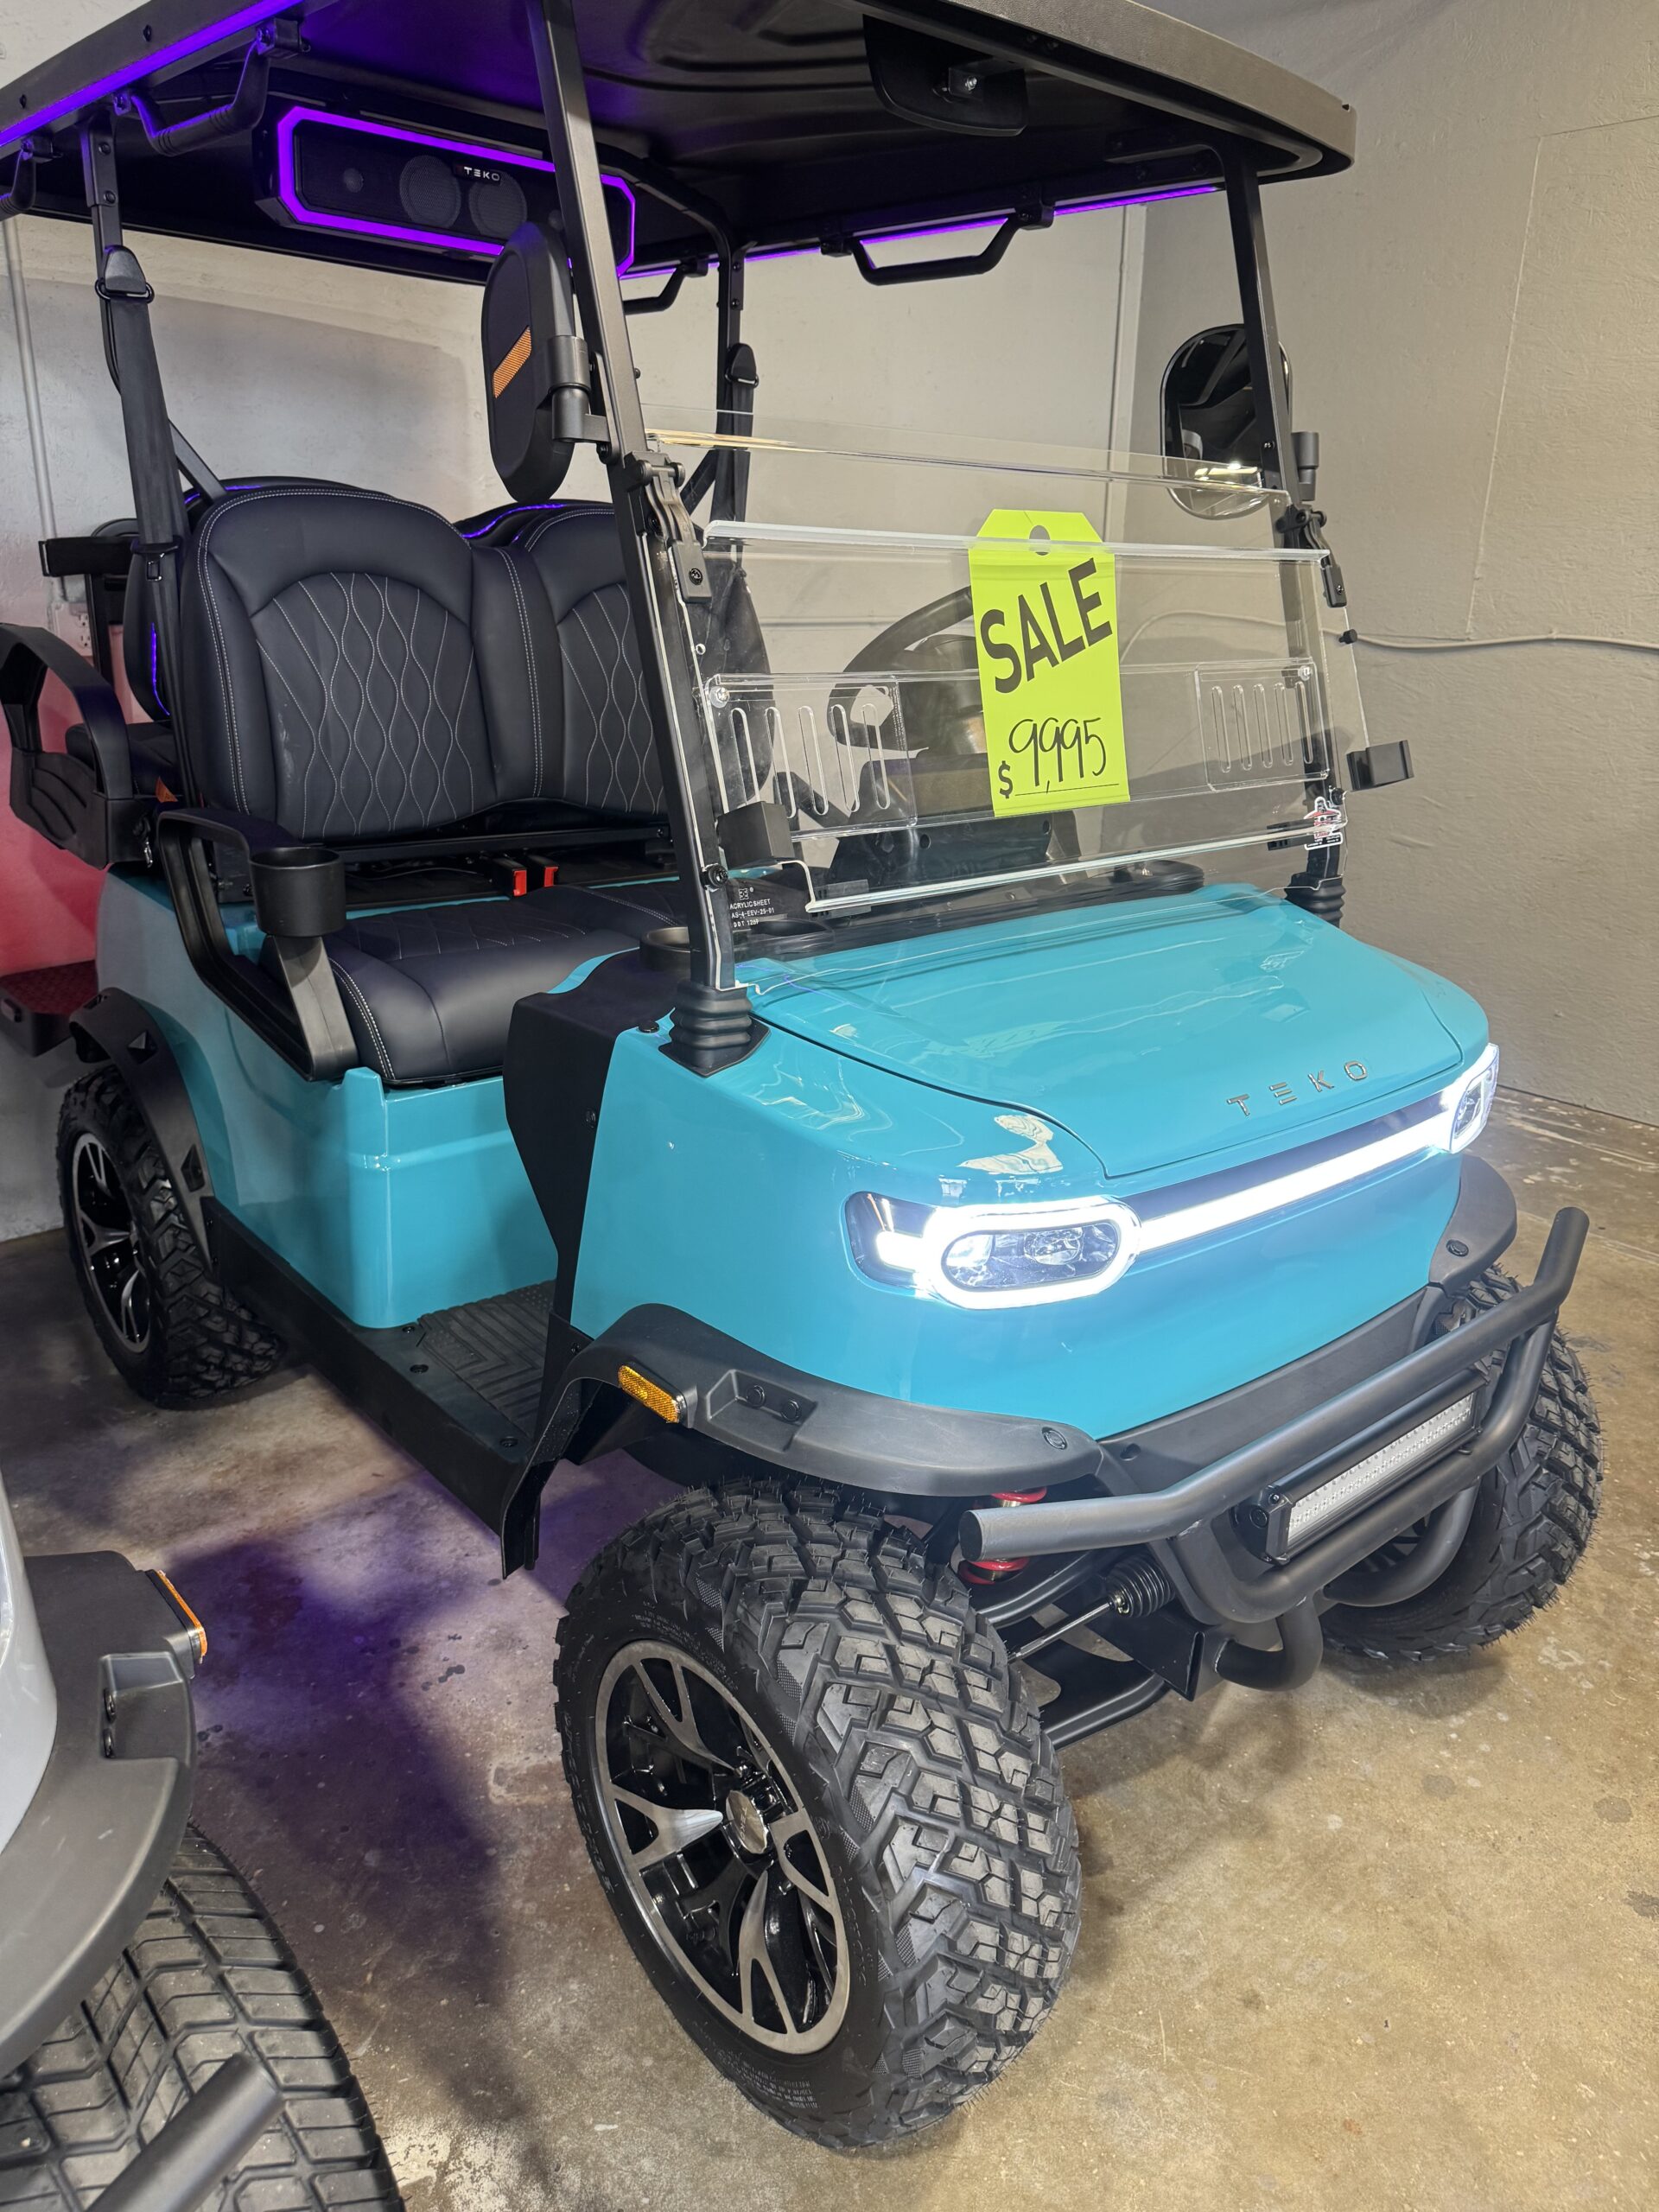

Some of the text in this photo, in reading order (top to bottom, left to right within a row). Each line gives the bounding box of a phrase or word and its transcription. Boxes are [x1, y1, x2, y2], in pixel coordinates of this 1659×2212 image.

[463, 166, 500, 181] TEKO
[979, 557, 1113, 694] SALE
[729, 899, 771, 910] ACRYLIC SHEET
[1226, 1060, 1369, 1116] TEKO
